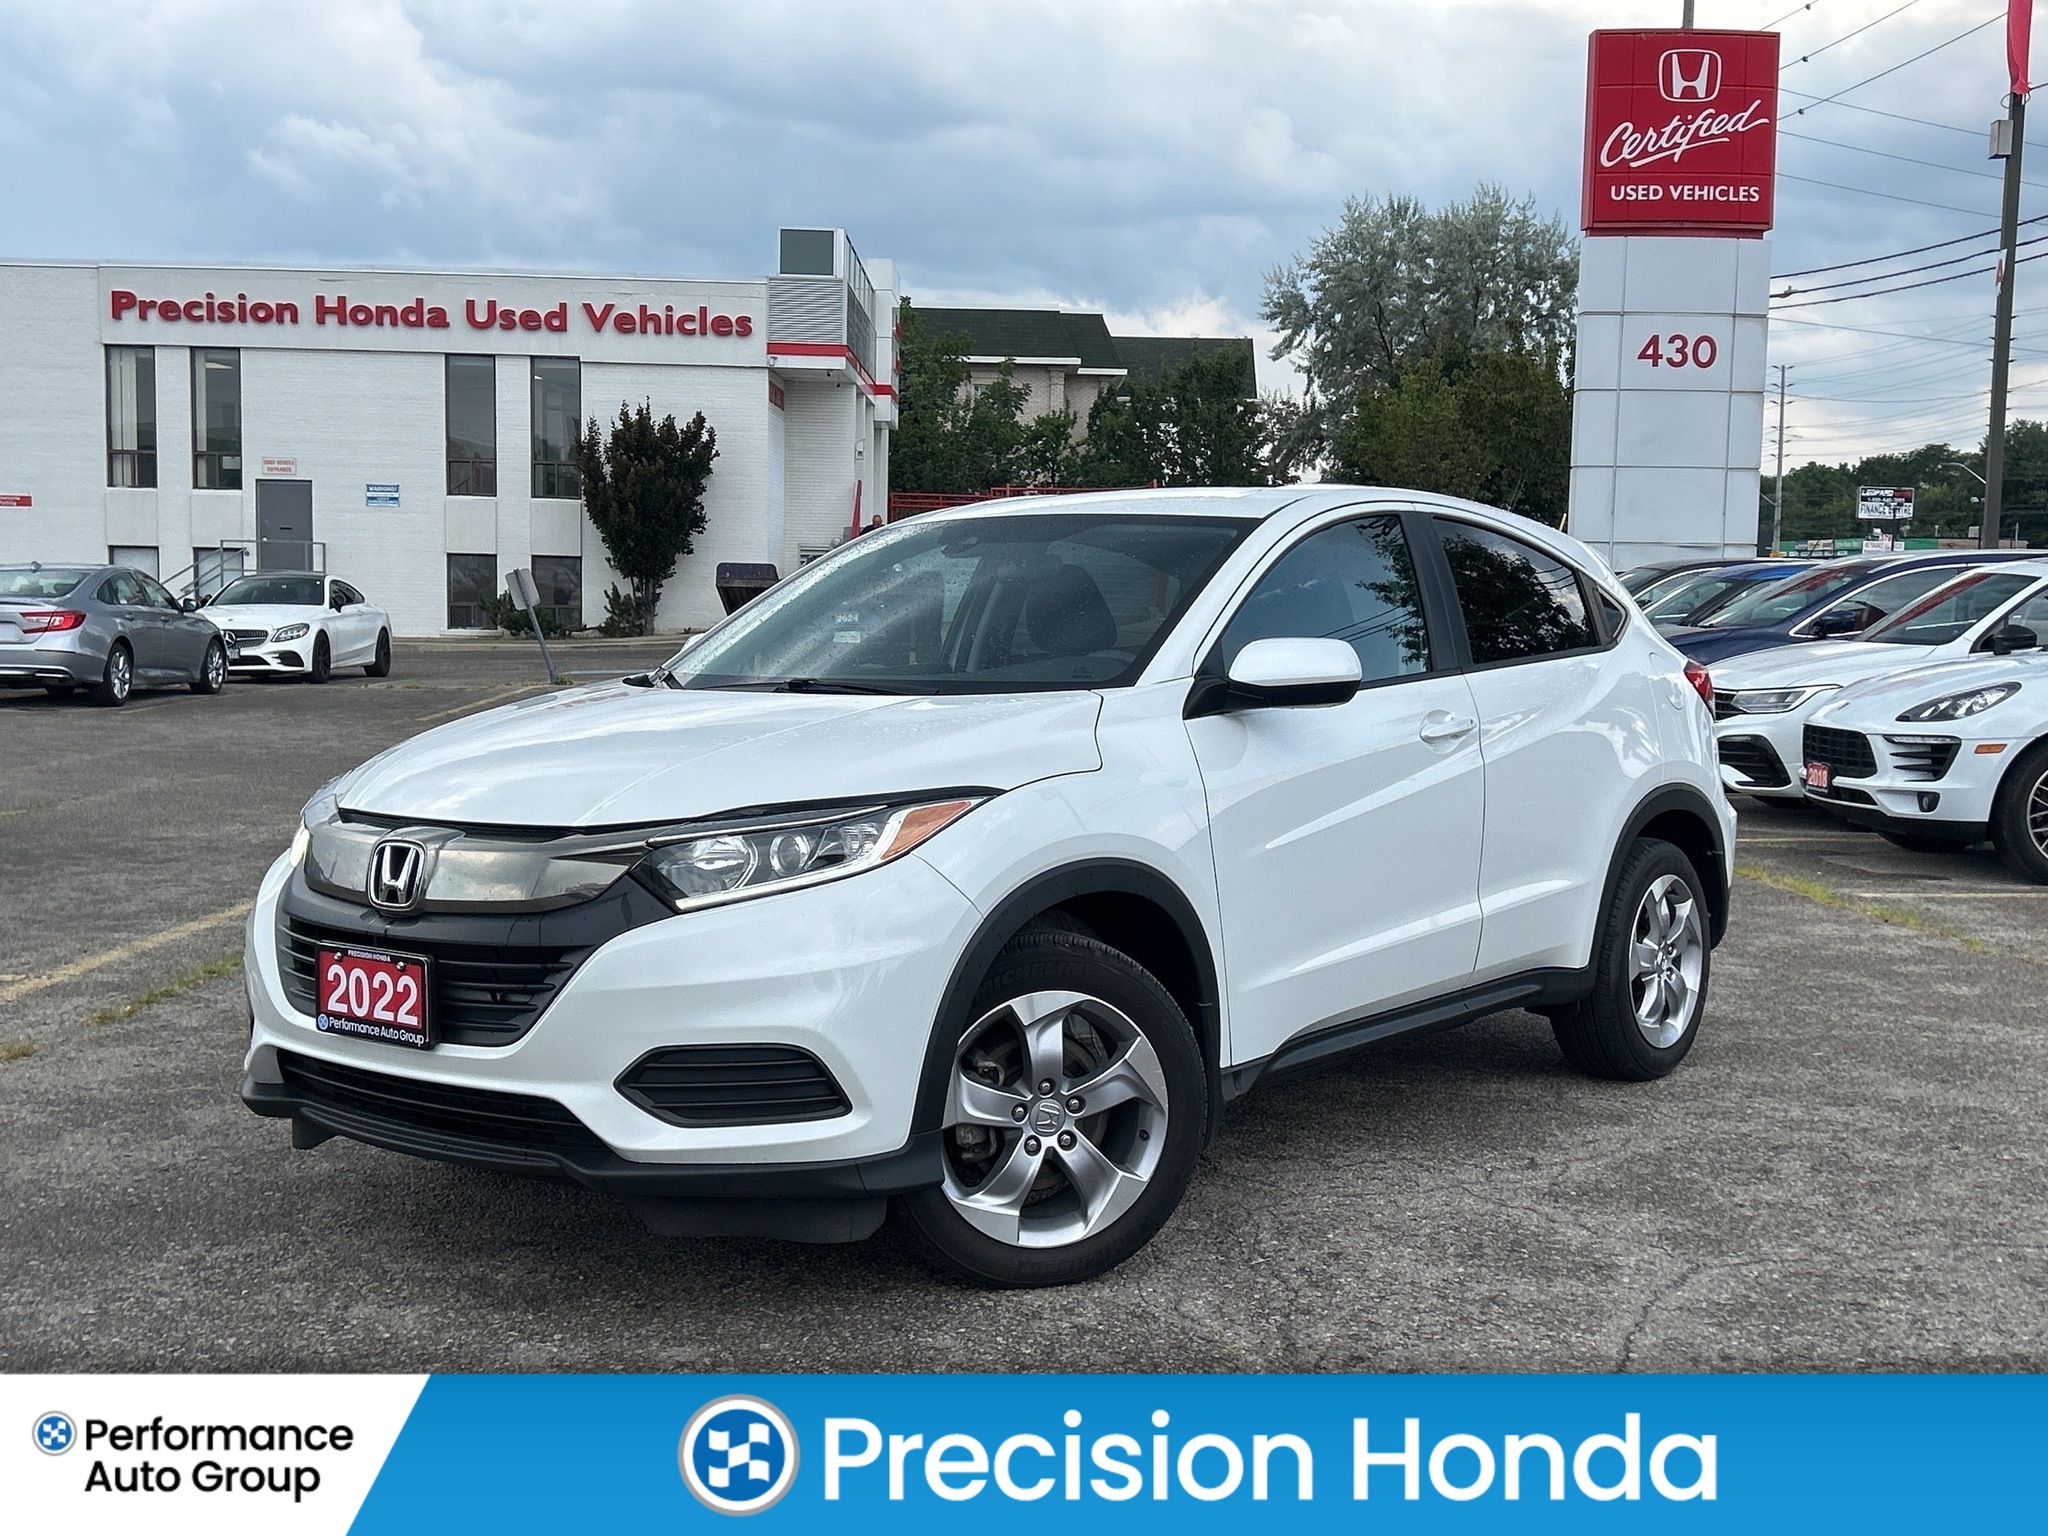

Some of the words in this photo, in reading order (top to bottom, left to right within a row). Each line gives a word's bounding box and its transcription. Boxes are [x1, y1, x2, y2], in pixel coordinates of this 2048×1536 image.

[1600, 99, 1770, 168] Certified
[1610, 185, 1663, 200] USED
[1669, 185, 1760, 201] VEHICLES
[110, 290, 299, 323] Precision
[315, 295, 450, 328] Honda
[465, 299, 568, 332] Used
[582, 302, 754, 336] Vehicles
[1637, 333, 1717, 369] 430
[347, 949, 373, 959] PRECISION
[373, 953, 391, 962] HONDA
[327, 964, 418, 1026] 2022
[329, 1017, 380, 1035] Performance
[380, 1025, 399, 1040] Auto
[400, 1029, 425, 1048] Group
